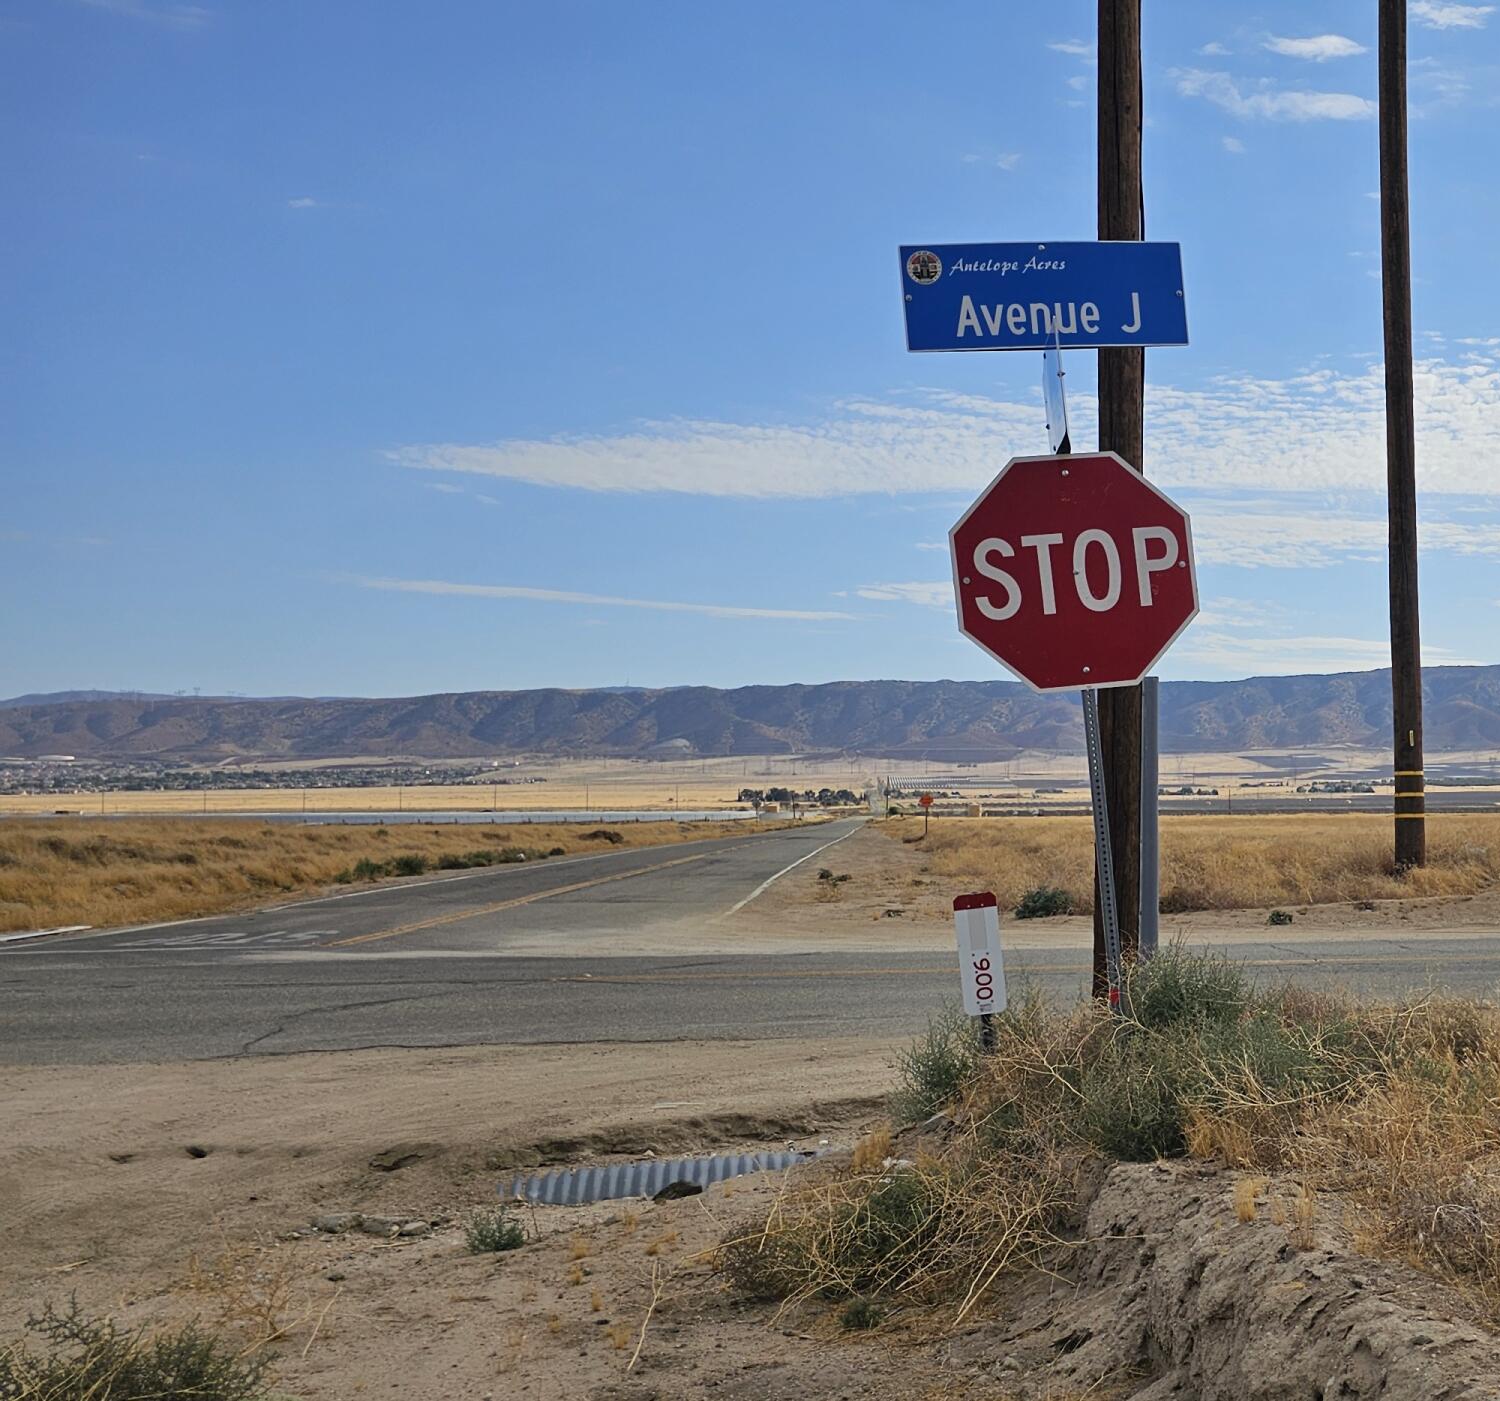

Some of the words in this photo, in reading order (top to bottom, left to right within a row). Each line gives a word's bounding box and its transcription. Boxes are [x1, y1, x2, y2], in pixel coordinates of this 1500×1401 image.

[949, 258, 1019, 276] Antelope
[1022, 256, 1066, 274] Acres
[956, 295, 1100, 337] Avenue
[1121, 292, 1142, 333] J
[973, 526, 1179, 621] STOP
